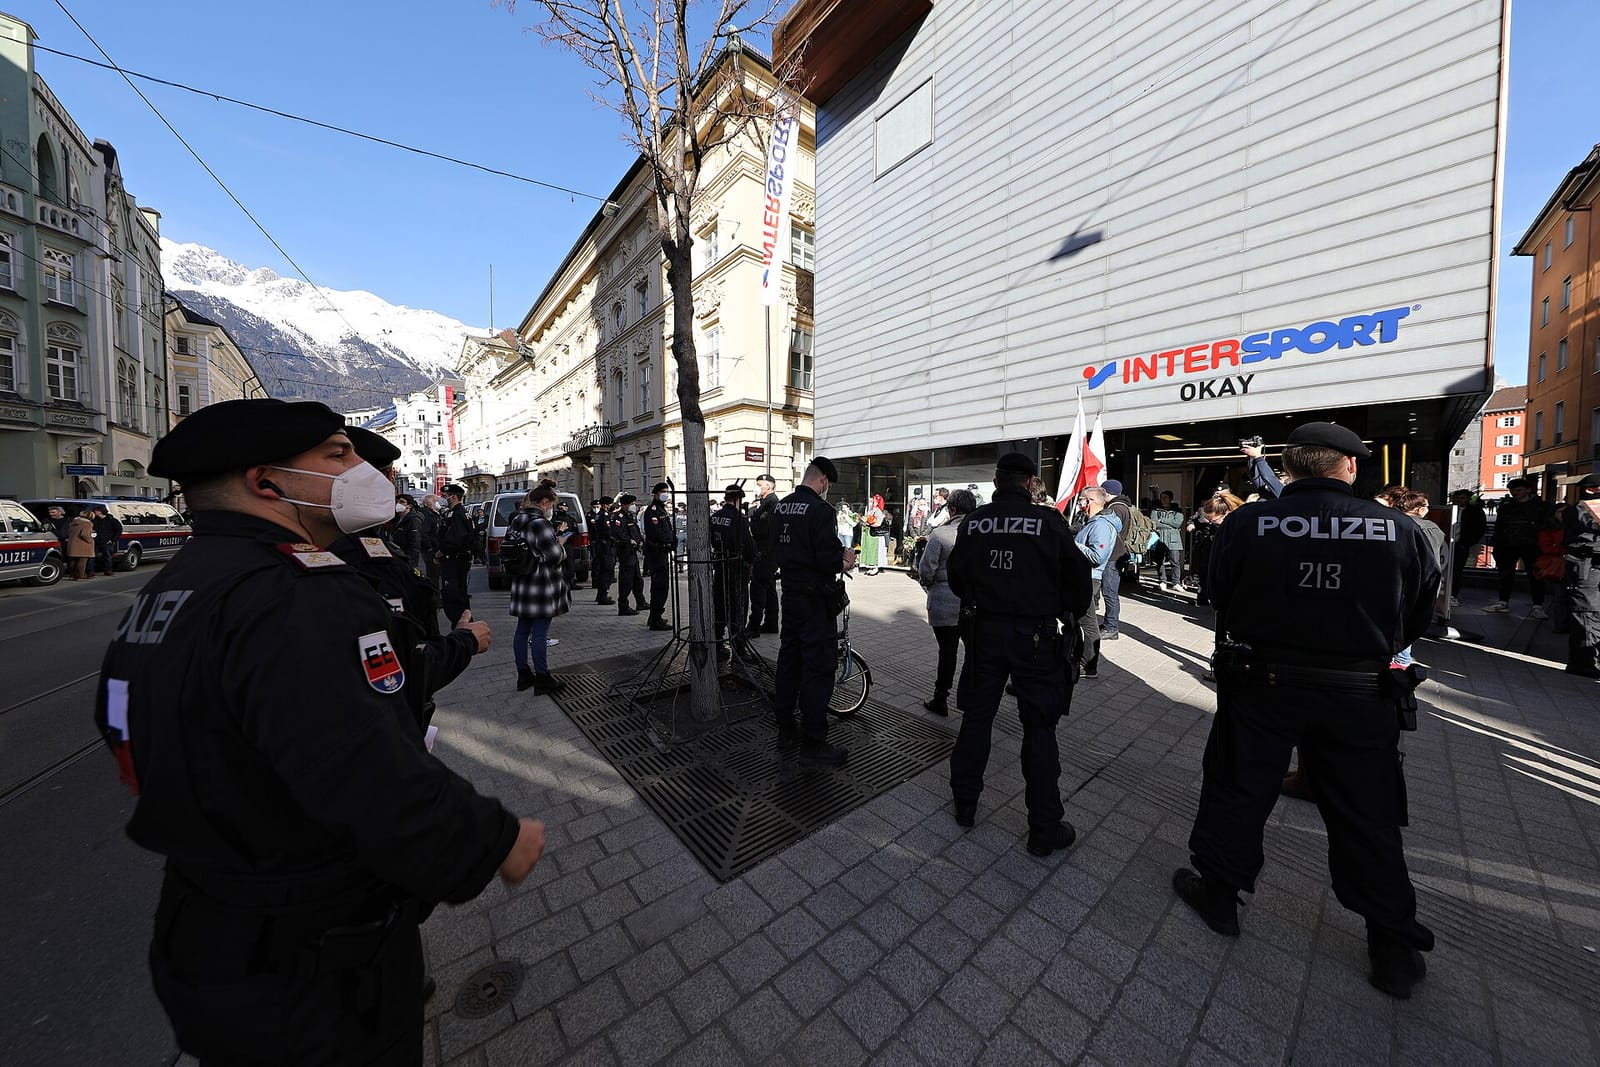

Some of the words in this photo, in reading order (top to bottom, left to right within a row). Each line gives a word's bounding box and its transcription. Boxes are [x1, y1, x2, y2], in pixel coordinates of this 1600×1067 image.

[1122, 307, 1410, 384] INTERSPORT
[1180, 374, 1255, 402] OKAY
[774, 503, 809, 515] POLIZEI
[967, 517, 1043, 536] POLIZEI
[1257, 515, 1397, 542] POLIZEI
[159, 536, 180, 546] POLIZEI
[989, 549, 1014, 570] 213
[1297, 561, 1342, 590] 213
[364, 642, 393, 668] EE
